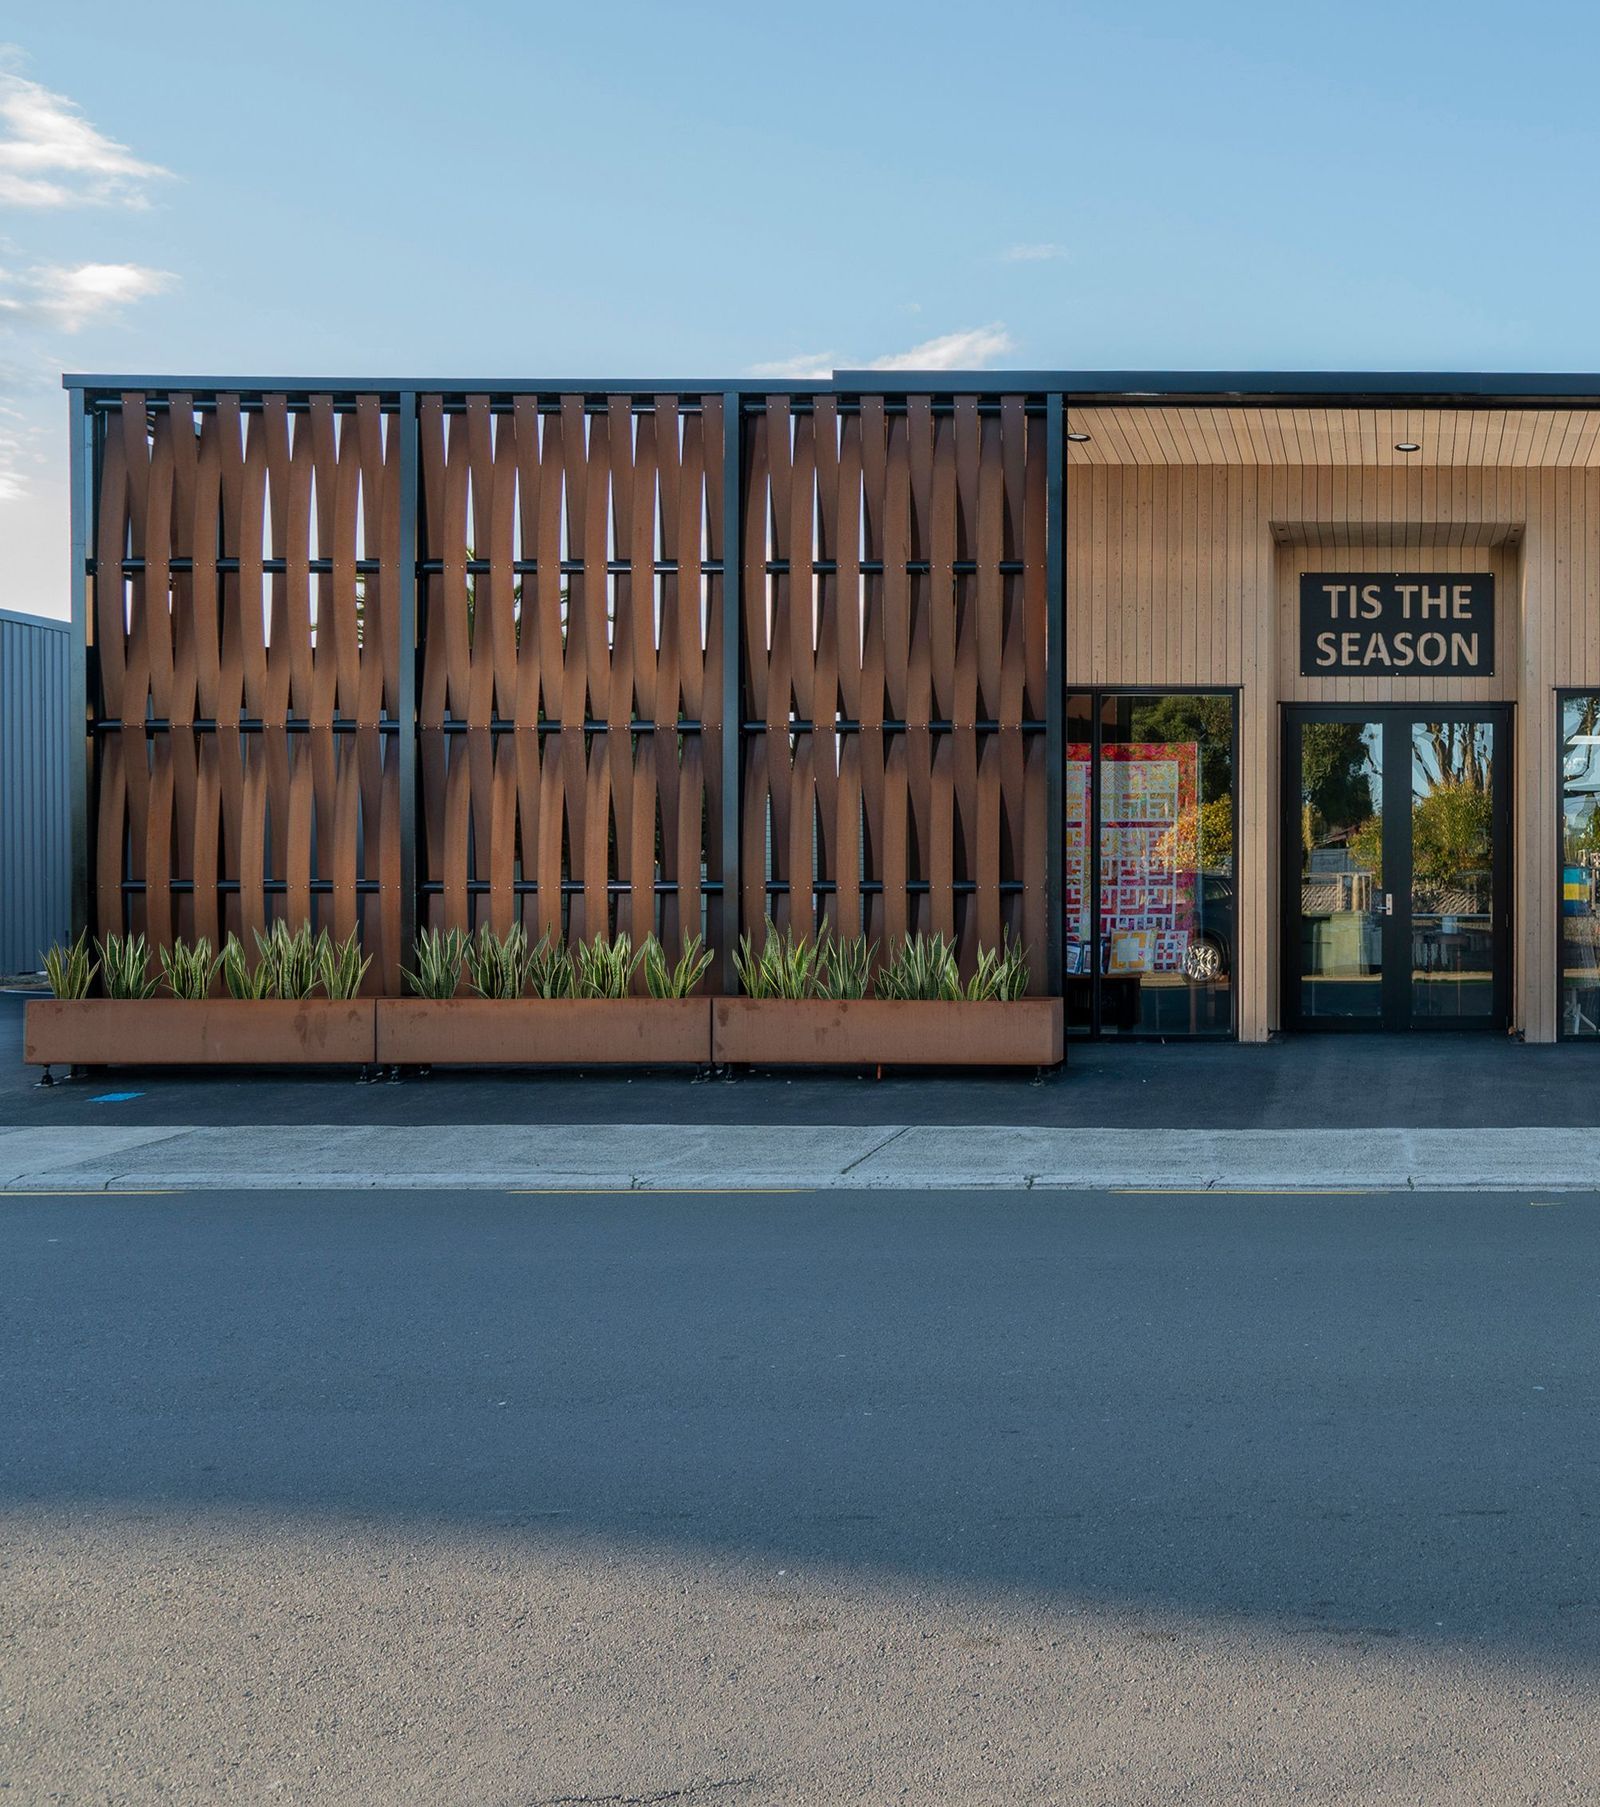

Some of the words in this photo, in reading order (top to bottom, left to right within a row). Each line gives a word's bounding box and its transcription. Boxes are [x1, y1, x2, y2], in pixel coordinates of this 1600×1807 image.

[1322, 585, 1383, 619] TIS
[1394, 585, 1473, 619] THE
[1316, 632, 1479, 666] SEASON
